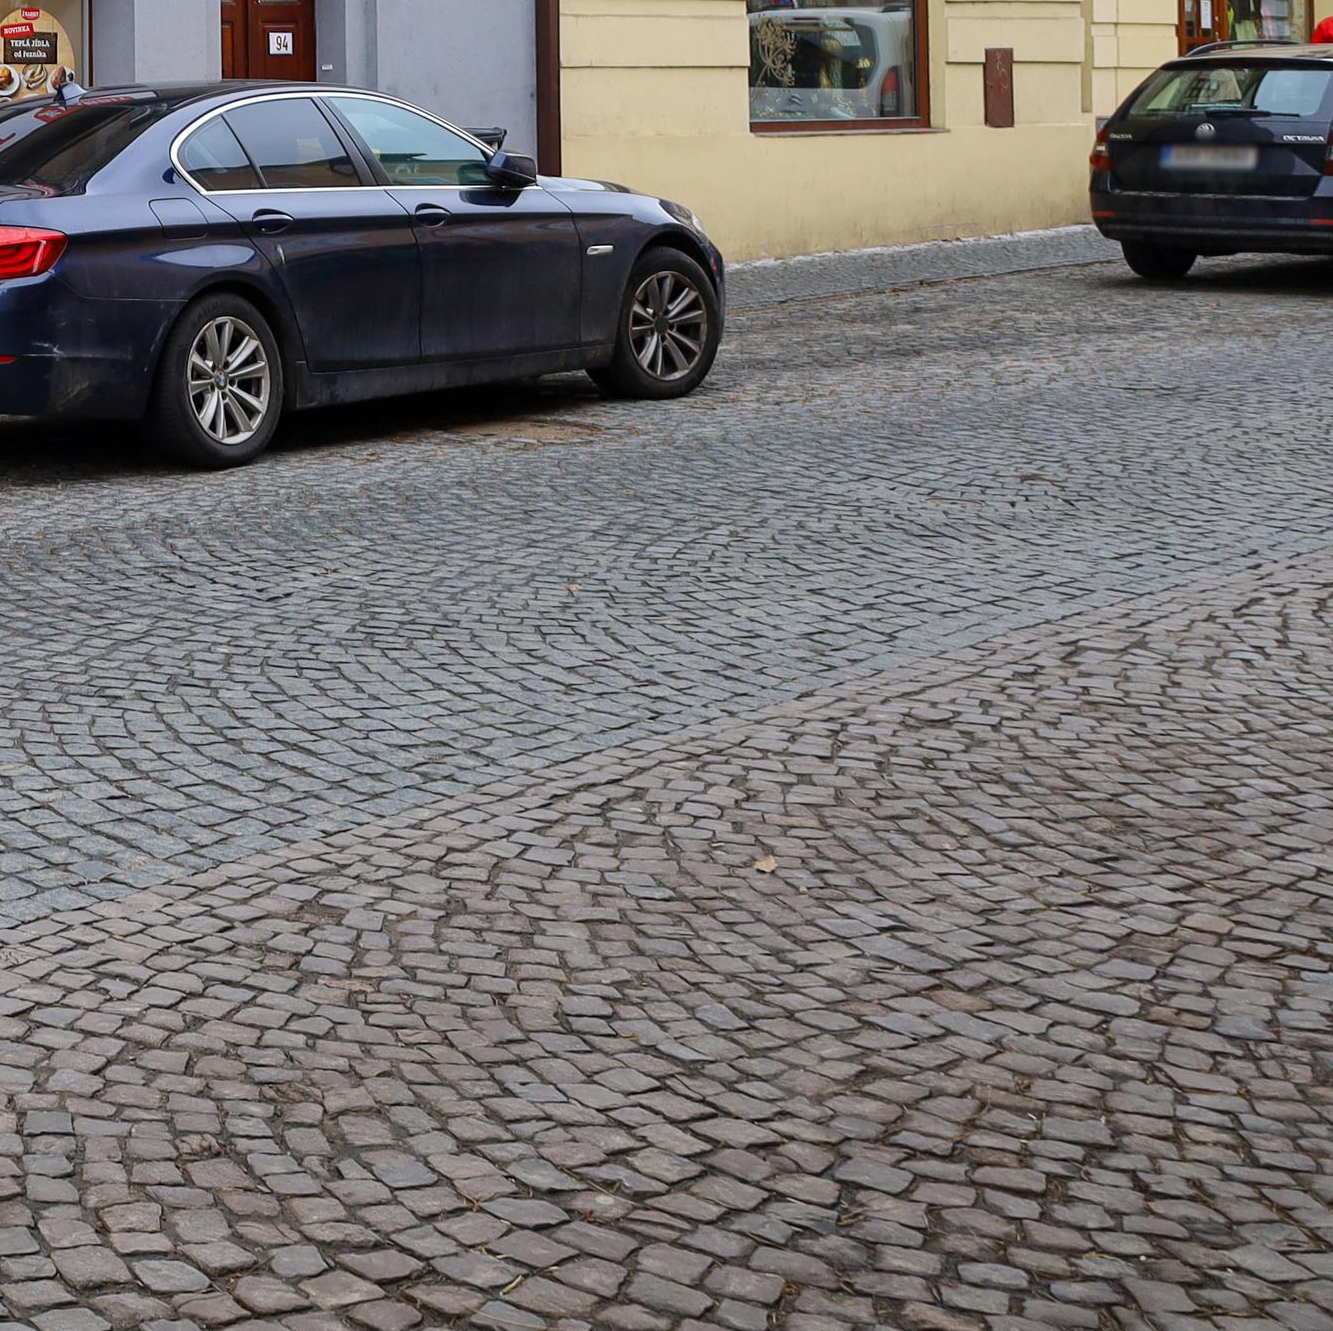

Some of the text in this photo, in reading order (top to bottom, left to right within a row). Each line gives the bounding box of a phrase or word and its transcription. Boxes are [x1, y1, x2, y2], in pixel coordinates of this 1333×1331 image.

[4, 26, 30, 34] NOVINKA
[10, 39, 50, 47] TEPLÁ JÍDLA
[276, 35, 288, 51] 94
[14, 50, 47, 58] od řezníka
